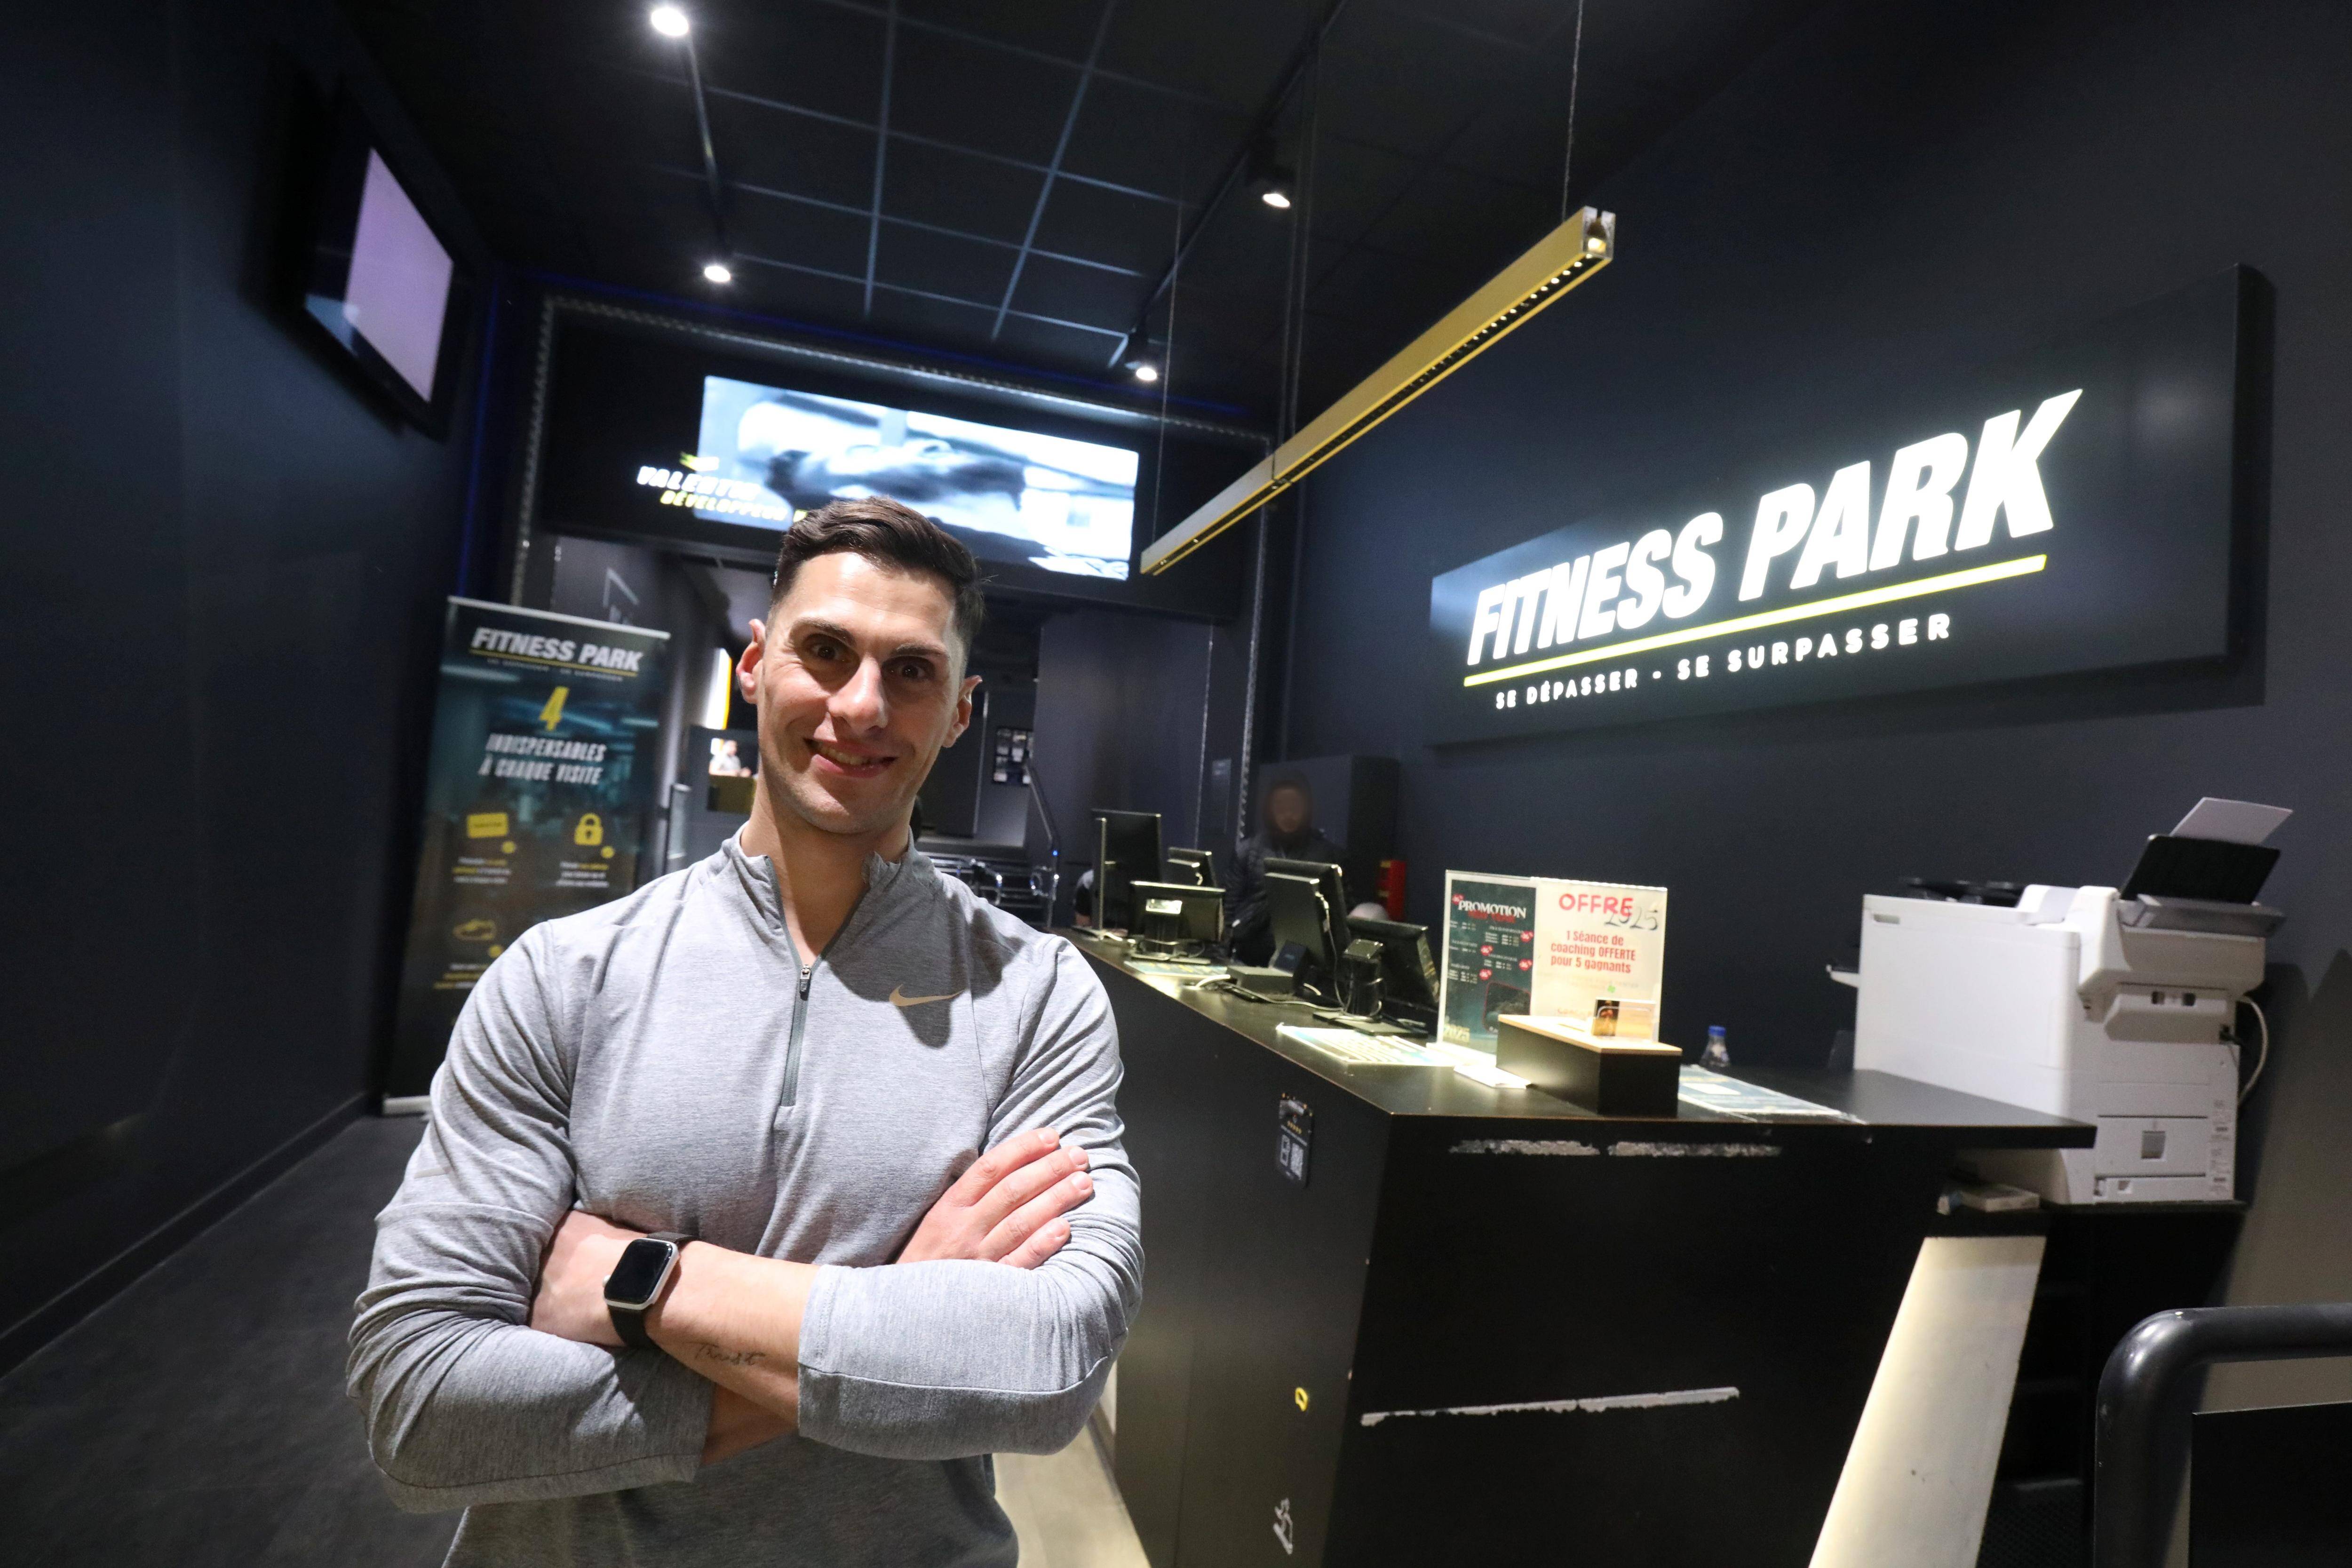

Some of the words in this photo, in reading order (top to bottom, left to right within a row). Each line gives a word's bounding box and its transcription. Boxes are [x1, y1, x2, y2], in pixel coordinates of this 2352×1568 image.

[1467, 511, 1723, 665] FITNESS
[1738, 388, 2083, 601] PARK
[471, 627, 577, 661] FITNESS
[578, 643, 644, 671] PARK
[1496, 692, 1517, 709] SE
[1526, 668, 1638, 705] DÉPASSER
[1677, 655, 1710, 680] SE
[1727, 613, 1950, 672] SURPASSER
[540, 685, 570, 731] 4
[485, 732, 607, 763] INDISPENSABLES
[494, 759, 554, 781] CHAQUE
[555, 764, 604, 785] VISITE
[1458, 900, 1527, 919] PROMOTION
[1558, 893, 1634, 917] OFFRE
[1566, 931, 1570, 940] 1
[1573, 931, 1609, 945] Séance
[1612, 935, 1624, 946] de
[1551, 943, 1595, 957] coaching
[1599, 947, 1637, 961] OFFERTE
[1551, 955, 1572, 966] pour
[1575, 957, 1581, 968] 5
[1585, 959, 1632, 973] gagnants
